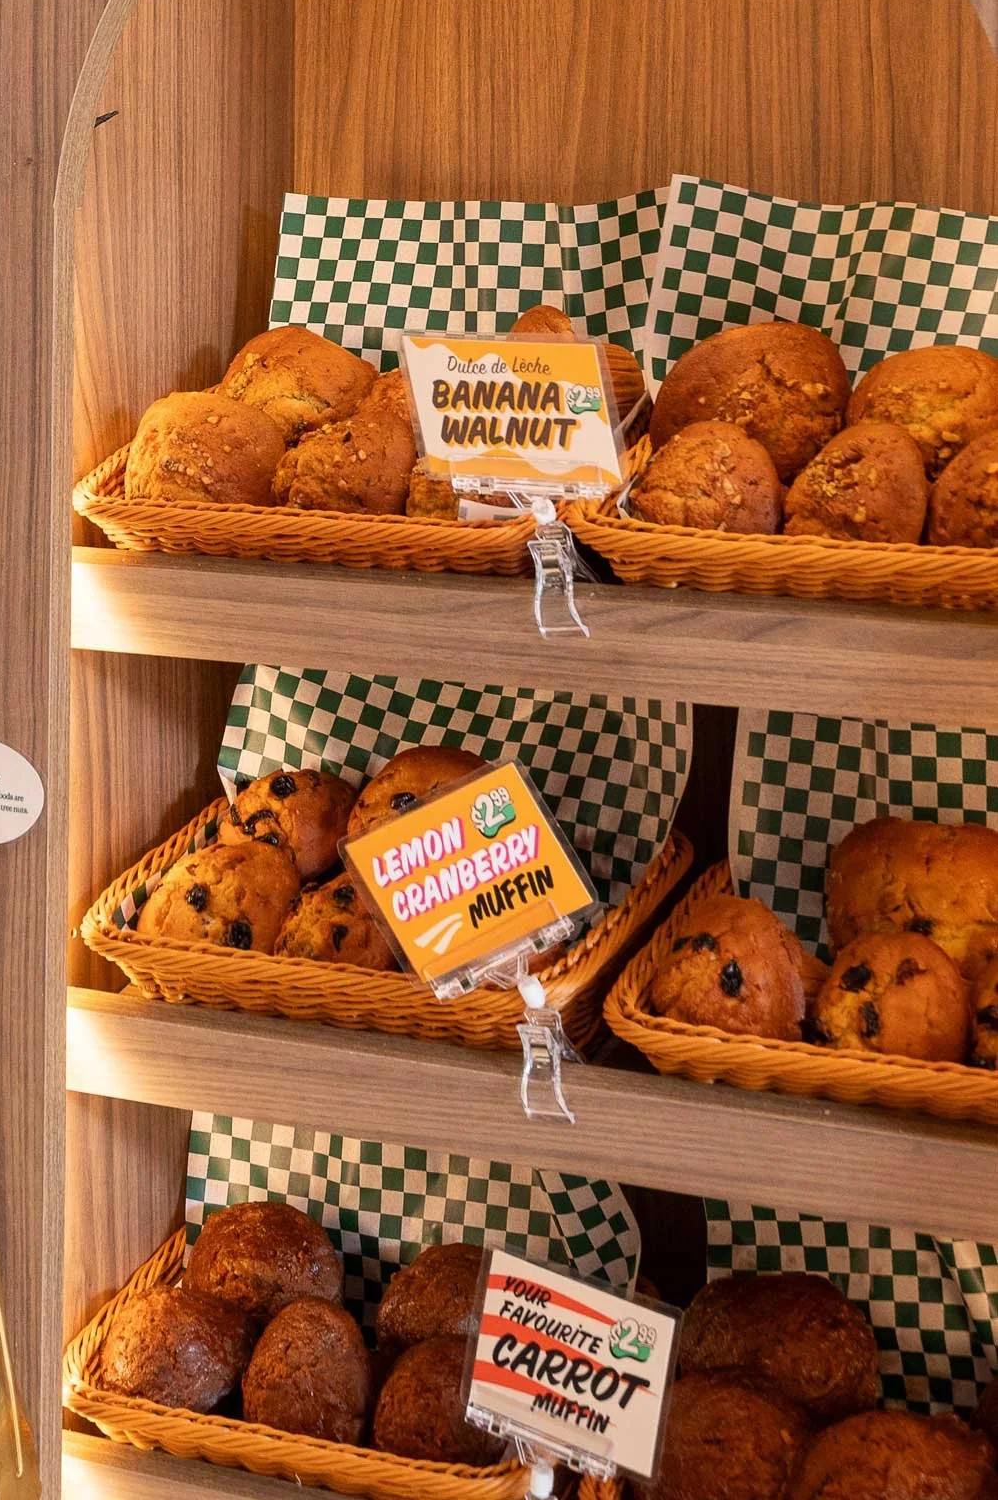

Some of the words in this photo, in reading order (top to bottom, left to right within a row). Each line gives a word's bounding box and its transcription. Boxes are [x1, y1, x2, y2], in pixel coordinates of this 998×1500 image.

[447, 355, 486, 374] Dulce
[491, 356, 507, 373] de
[432, 379, 561, 411] BANANA
[440, 415, 577, 448] WALNUT
[372, 817, 464, 888] LEMON
[392, 824, 538, 921] CRANBERRY
[468, 865, 554, 929] MUFFIN
[503, 1276, 551, 1308] YOUR
[493, 1333, 650, 1409] CARROT
[530, 1393, 610, 1434] MUFFIN
